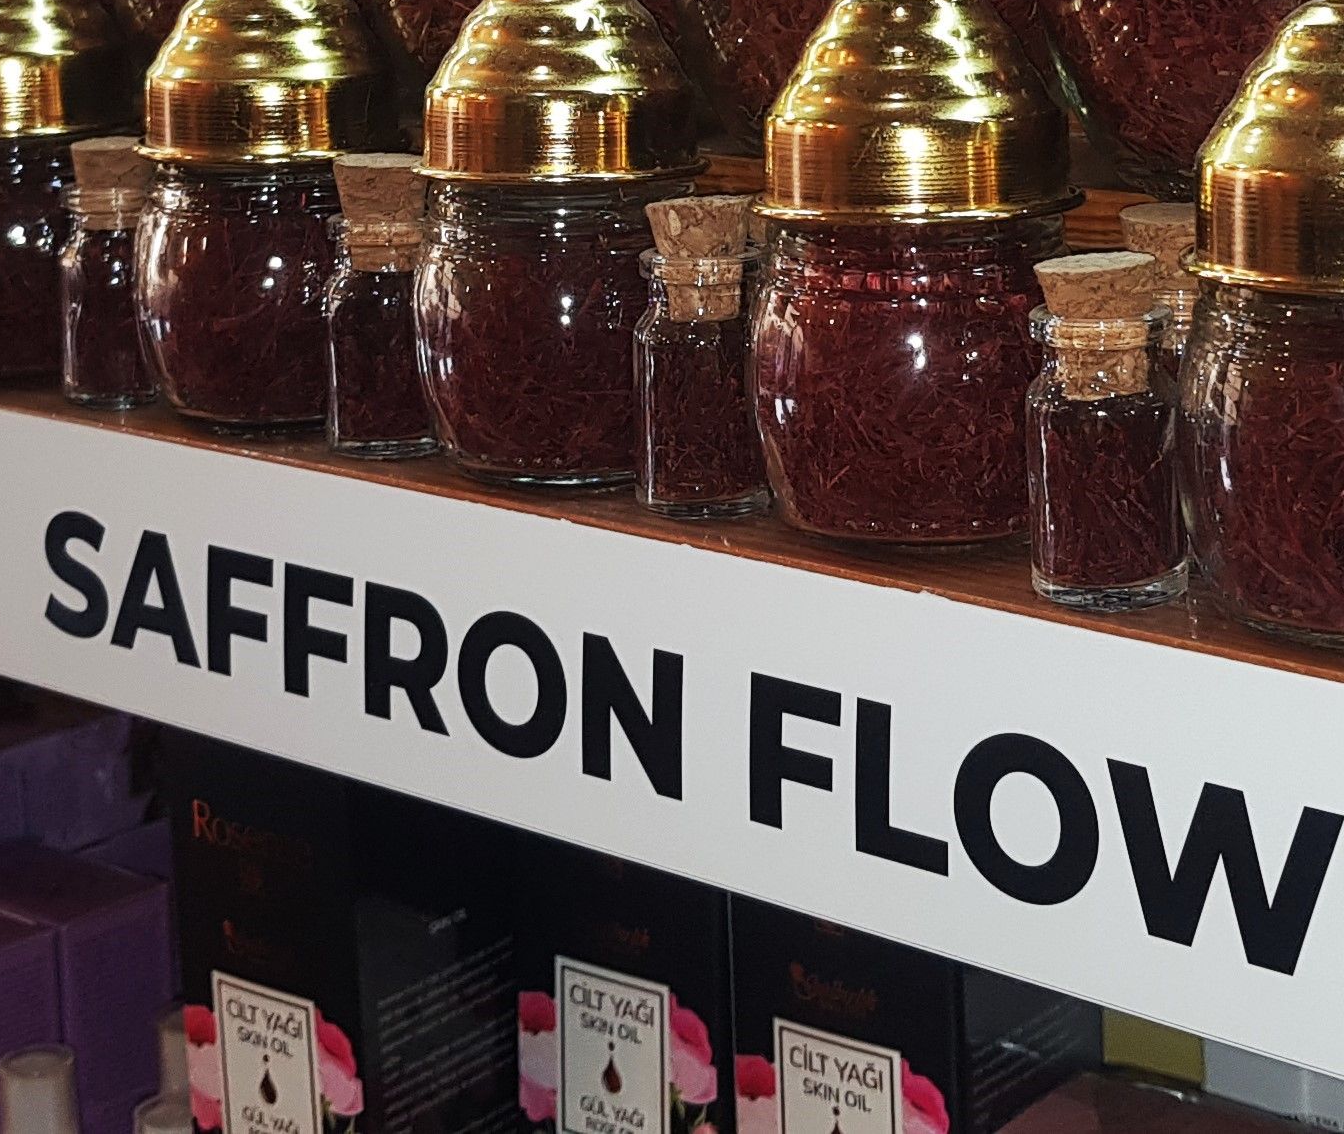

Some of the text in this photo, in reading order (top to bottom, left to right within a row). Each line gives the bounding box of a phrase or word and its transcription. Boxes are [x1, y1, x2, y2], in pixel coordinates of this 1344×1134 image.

[44, 511, 685, 802] SAFFRON
[789, 1043, 884, 1094] CİLT YAĞI
[803, 1077, 873, 1113] SKIN OIL
